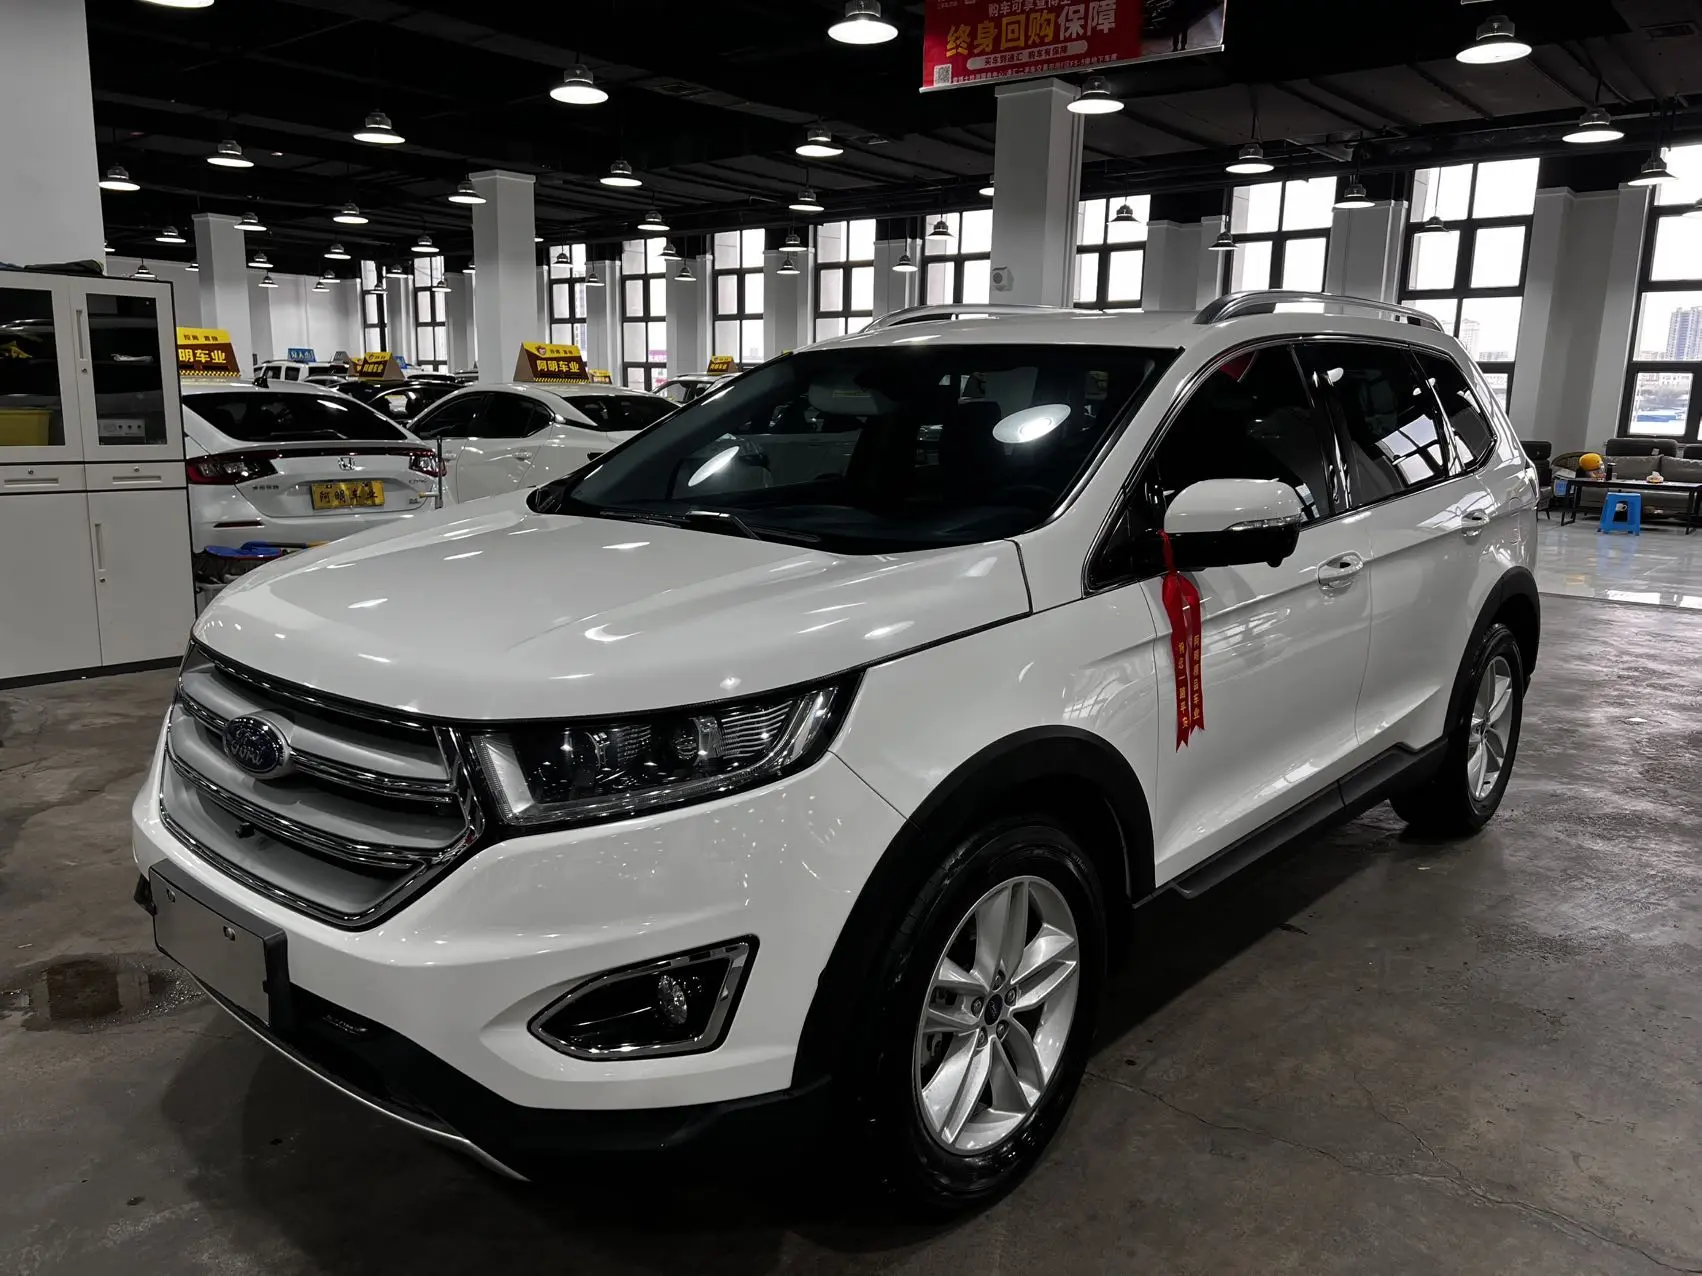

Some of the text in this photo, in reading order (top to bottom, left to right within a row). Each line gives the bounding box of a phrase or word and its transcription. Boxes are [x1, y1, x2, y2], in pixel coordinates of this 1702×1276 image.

[946, 1, 1117, 57] 终身回购保障
[536, 359, 580, 373] 阿明车业
